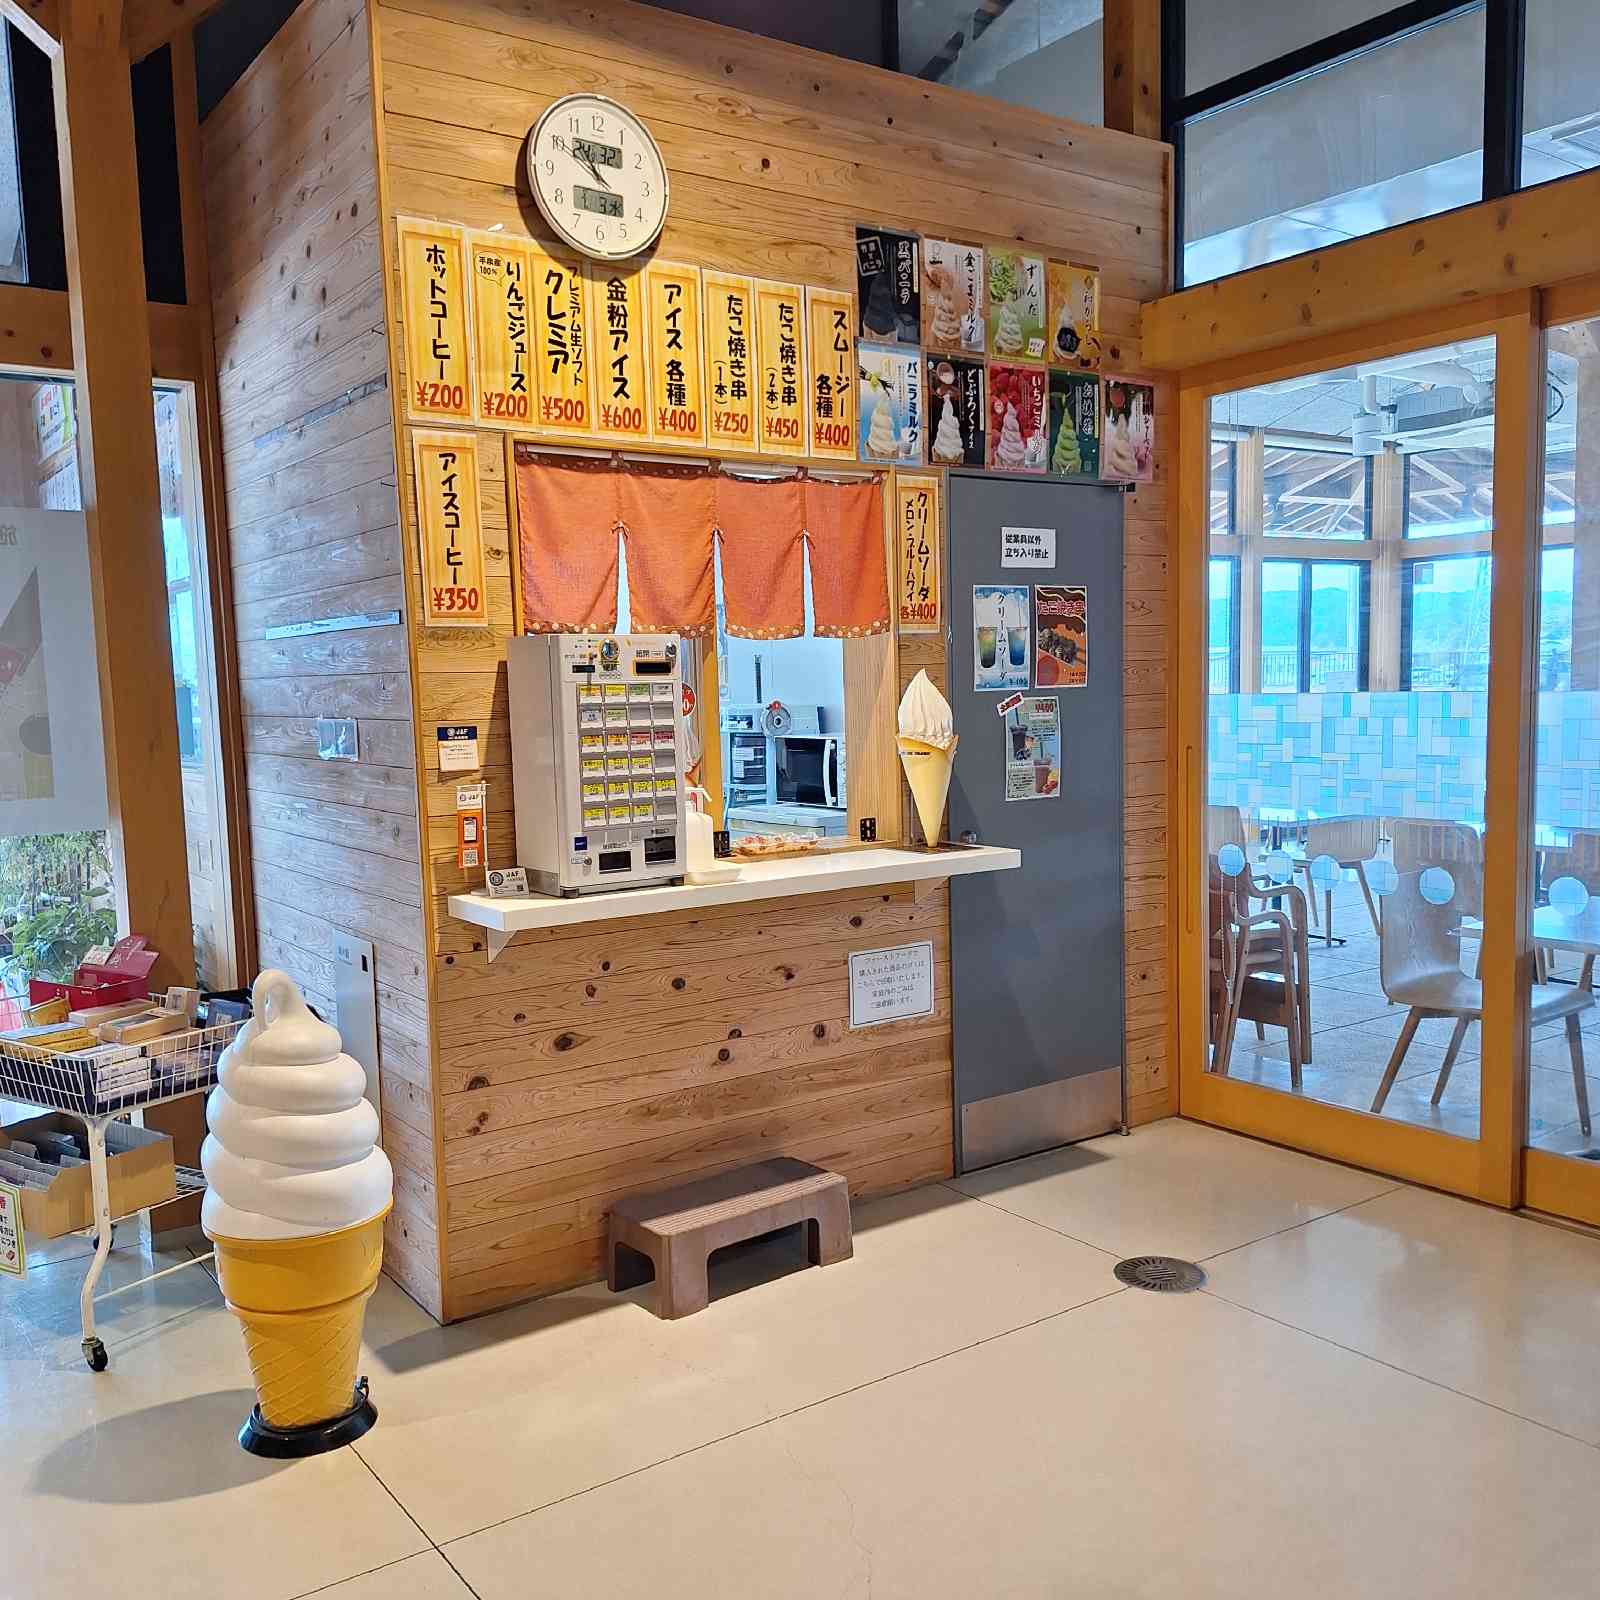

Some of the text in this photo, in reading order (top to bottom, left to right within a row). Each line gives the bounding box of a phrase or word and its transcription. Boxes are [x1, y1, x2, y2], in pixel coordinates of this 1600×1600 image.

[569, 117, 580, 134] 11
[592, 115, 605, 132] 12
[618, 130, 625, 145] 1
[545, 160, 554, 176] 9
[634, 153, 642, 169] 2
[554, 188, 564, 205] 8
[641, 181, 650, 197] 3
[573, 213, 581, 228] 7
[634, 208, 643, 223] 4
[595, 225, 605, 241] 6
[618, 223, 627, 239] 5
[1026, 264, 1038, 317] ずんだ
[426, 244, 450, 380] ホットコーヒー
[544, 270, 570, 375] クレミア
[506, 262, 527, 393] りんごジュース
[607, 277, 630, 400] 金粉アイス
[664, 284, 687, 407] アイス 各種
[727, 295, 748, 400] たこ焼き串
[778, 303, 797, 406] たこ焼き串
[833, 310, 850, 417] スムージー
[416, 380, 464, 410] ¥200
[484, 392, 528, 418] ¥200
[816, 374, 833, 418] 各種
[907, 361, 918, 443] バニラミルク
[542, 396, 585, 423] ¥500
[602, 404, 642, 430] ¥600
[659, 408, 697, 433] ¥400
[965, 368, 977, 449] どぶろくアイス
[714, 411, 749, 434] ¥250
[766, 417, 799, 439] ¥450
[816, 422, 850, 446] ¥400
[438, 452, 463, 585] アイスコーヒー
[917, 492, 930, 602] クリームソーダ
[1005, 533, 1042, 545] 従業員以外
[1004, 547, 1049, 559] 立ち入り禁止
[433, 587, 479, 611] ¥350
